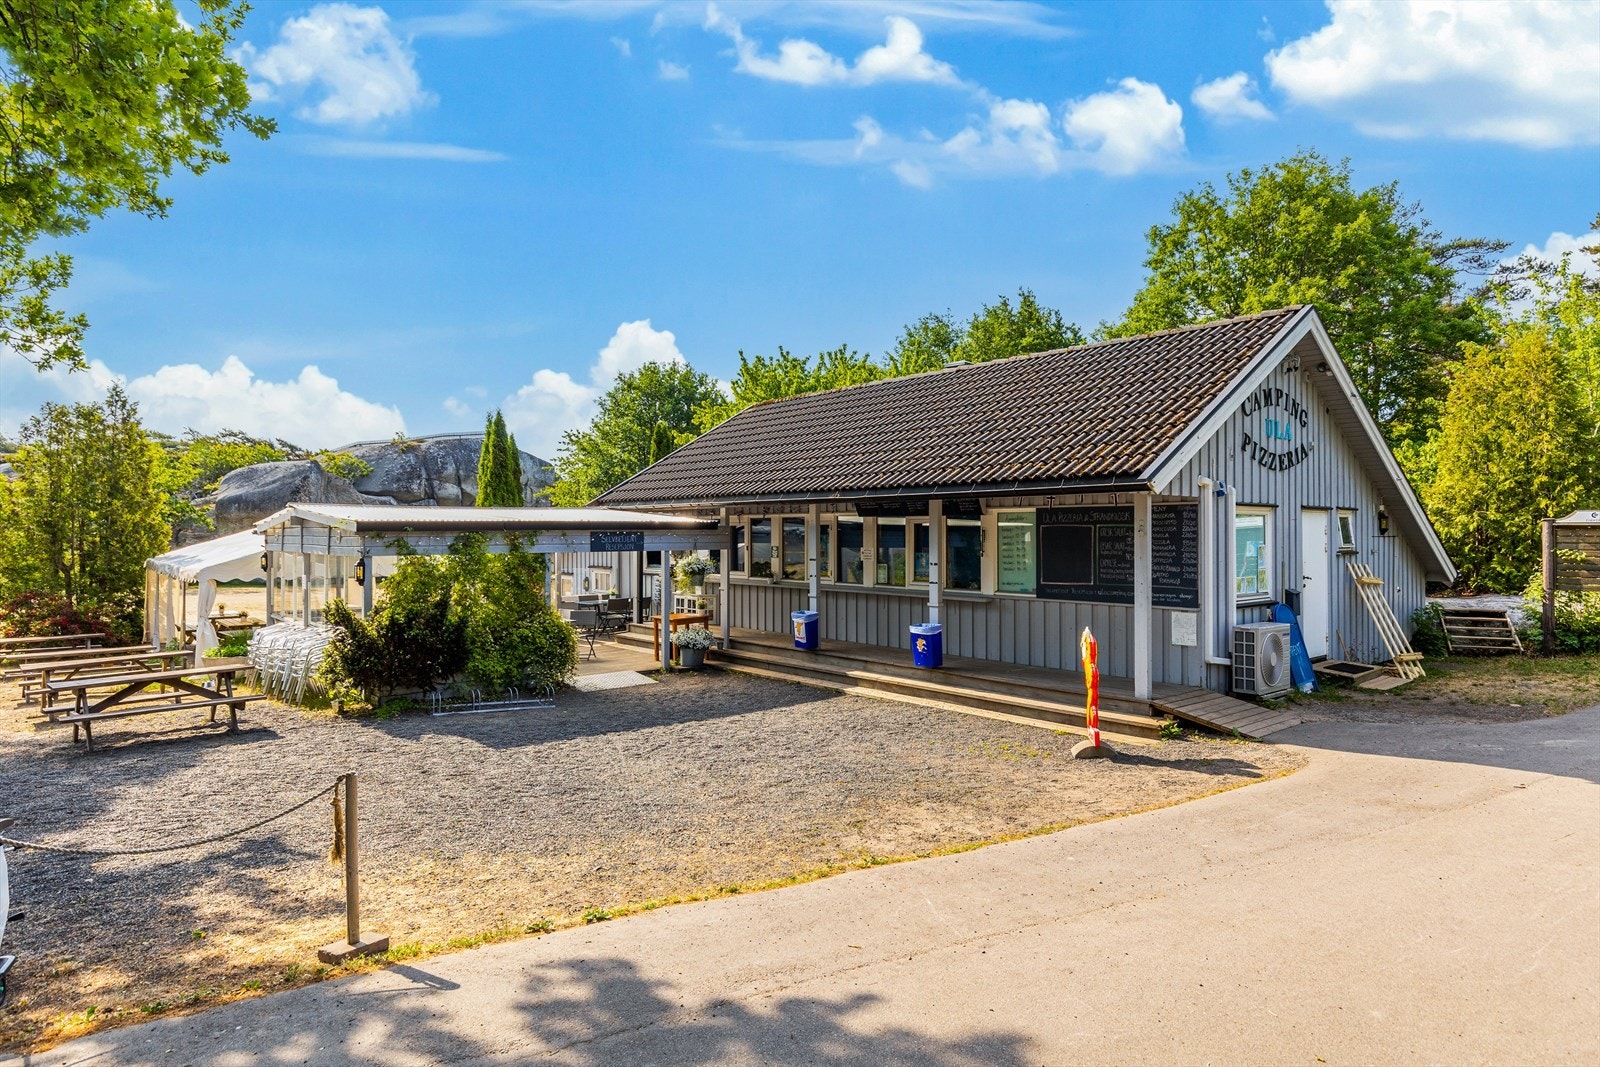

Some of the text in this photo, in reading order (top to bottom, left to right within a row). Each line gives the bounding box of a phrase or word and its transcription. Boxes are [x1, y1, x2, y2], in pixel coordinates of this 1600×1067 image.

[1241, 387, 1308, 428] CAMPING
[1264, 418, 1293, 442] ULA
[1241, 432, 1309, 472] PIZZERIA
[1058, 511, 1083, 523] PIZZERIA
